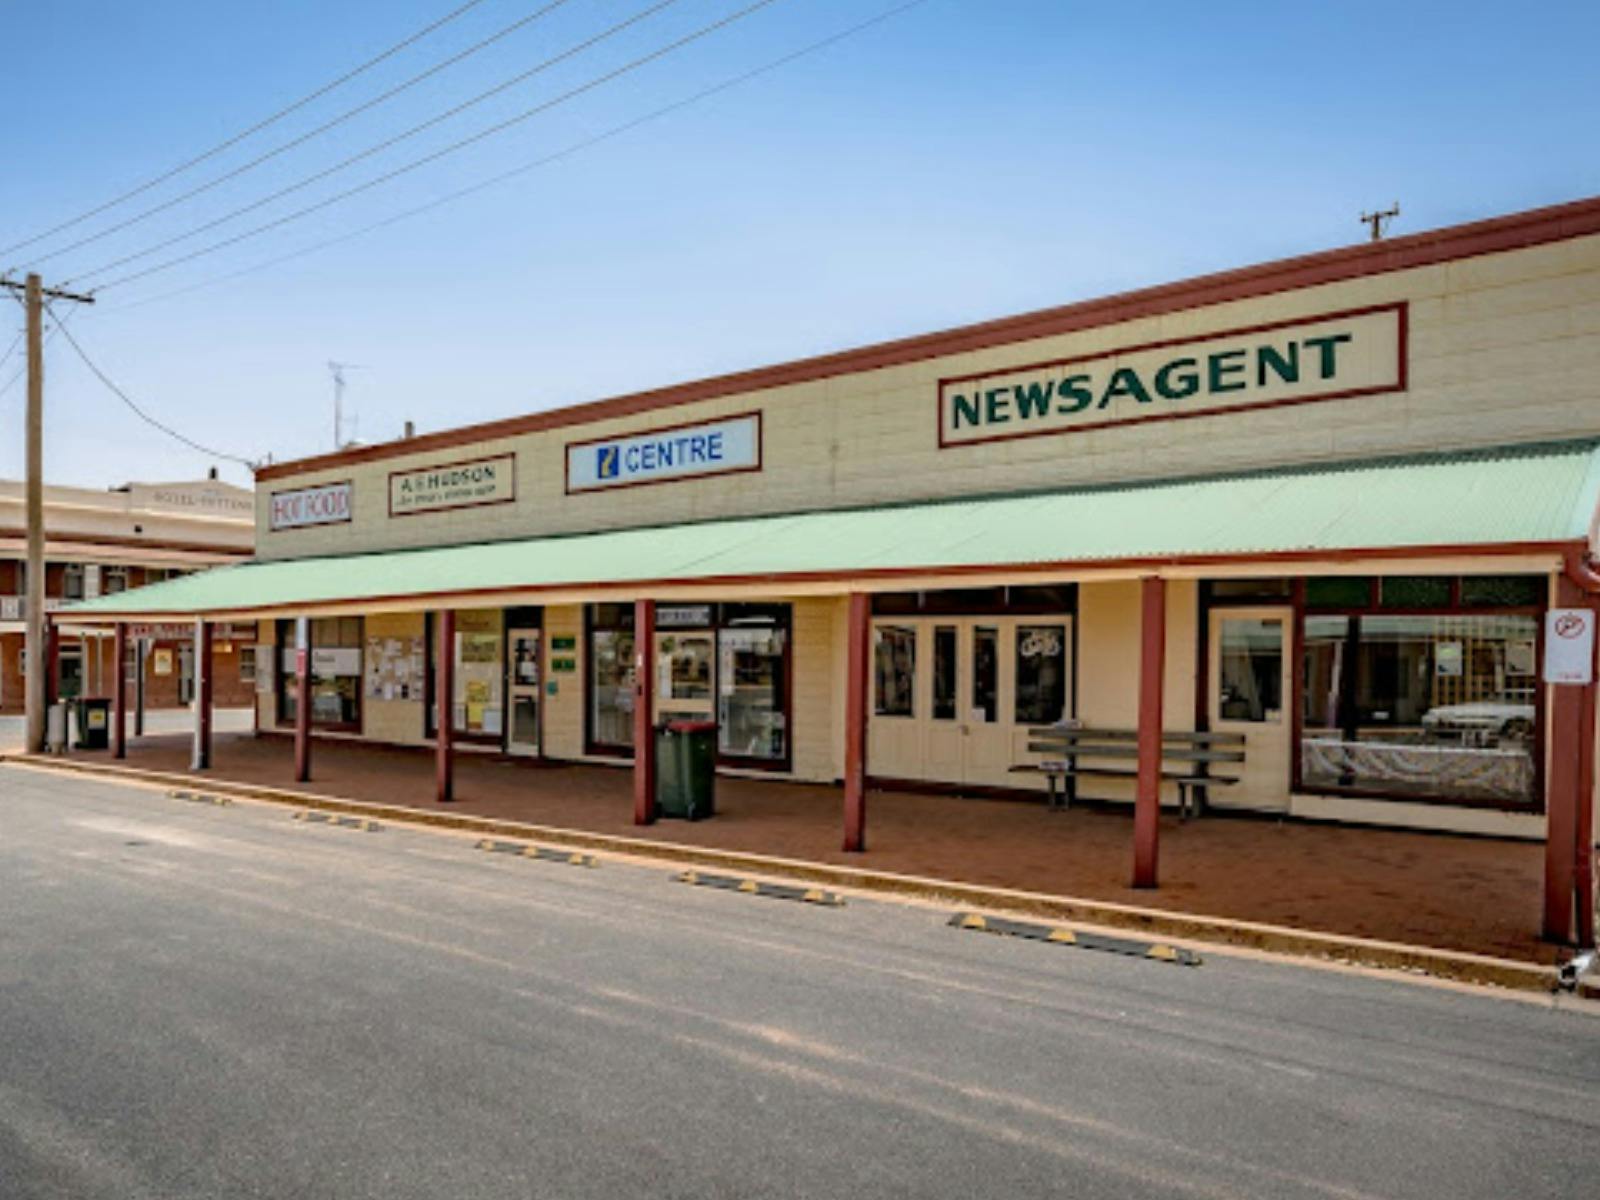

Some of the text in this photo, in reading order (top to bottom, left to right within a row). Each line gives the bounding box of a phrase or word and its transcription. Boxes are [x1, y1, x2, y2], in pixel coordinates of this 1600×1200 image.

[951, 333, 1352, 429] NEWSAGENT
[625, 431, 724, 473] CENTRE
[401, 477, 413, 493] A
[427, 464, 497, 489] HUDSON
[274, 489, 349, 523] HOT FOOD
